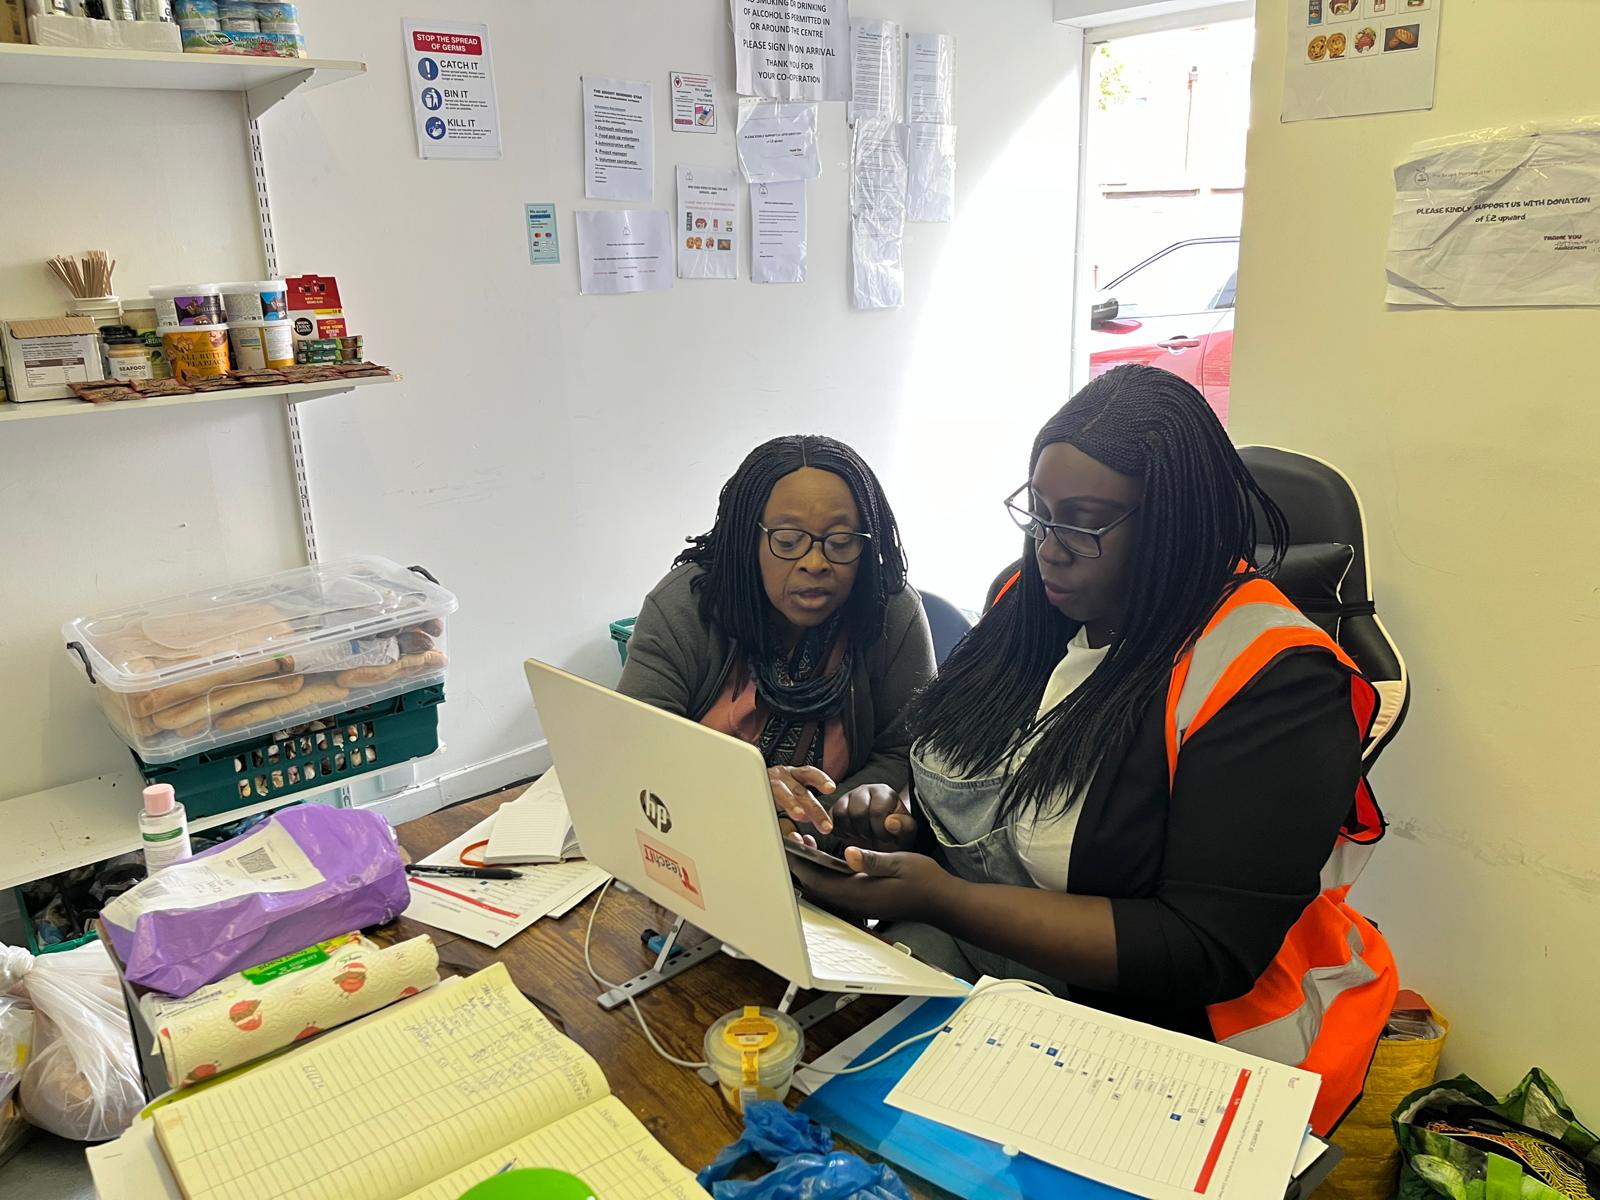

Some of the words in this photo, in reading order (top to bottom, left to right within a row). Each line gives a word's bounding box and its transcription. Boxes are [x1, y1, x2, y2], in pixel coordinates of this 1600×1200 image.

[797, 2, 826, 12] DRINKING
[743, 7, 751, 15] OF
[752, 9, 783, 20] ALCOHOL
[784, 12, 790, 20] IS
[791, 13, 821, 25] PERMITTED
[750, 22, 760, 31] OR
[761, 23, 790, 33] AROUND
[791, 26, 800, 35] THE
[800, 28, 823, 38] CENTRE
[416, 34, 435, 42] STOP
[451, 36, 478, 45] SPREAD
[442, 44, 466, 52] GERMS
[743, 39, 767, 50] PLEASE
[768, 41, 785, 51] SIGN
[787, 43, 794, 52] IN
[794, 45, 804, 54] ON
[805, 46, 836, 57] ARRIVAL
[440, 60, 469, 69] CATCH
[471, 62, 479, 70] IT
[765, 58, 788, 68] THANK
[789, 61, 800, 70] YOU
[801, 62, 814, 70] FOR
[758, 71, 776, 80] YOUR
[776, 73, 821, 83] CO-OPERATION
[444, 89, 459, 98] BIN
[460, 90, 468, 98] IT
[447, 118, 466, 127] KILL
[468, 119, 476, 127] IT
[1416, 206, 1444, 215] PLEASE
[1445, 204, 1472, 214] KINDLY
[1474, 201, 1510, 210] SUPPORT
[1523, 199, 1546, 207] WITH
[1546, 196, 1591, 206] DONATION
[1475, 215, 1484, 223] of
[1485, 214, 1497, 222] £2
[1498, 213, 1526, 223] upward
[642, 787, 671, 833] hp
